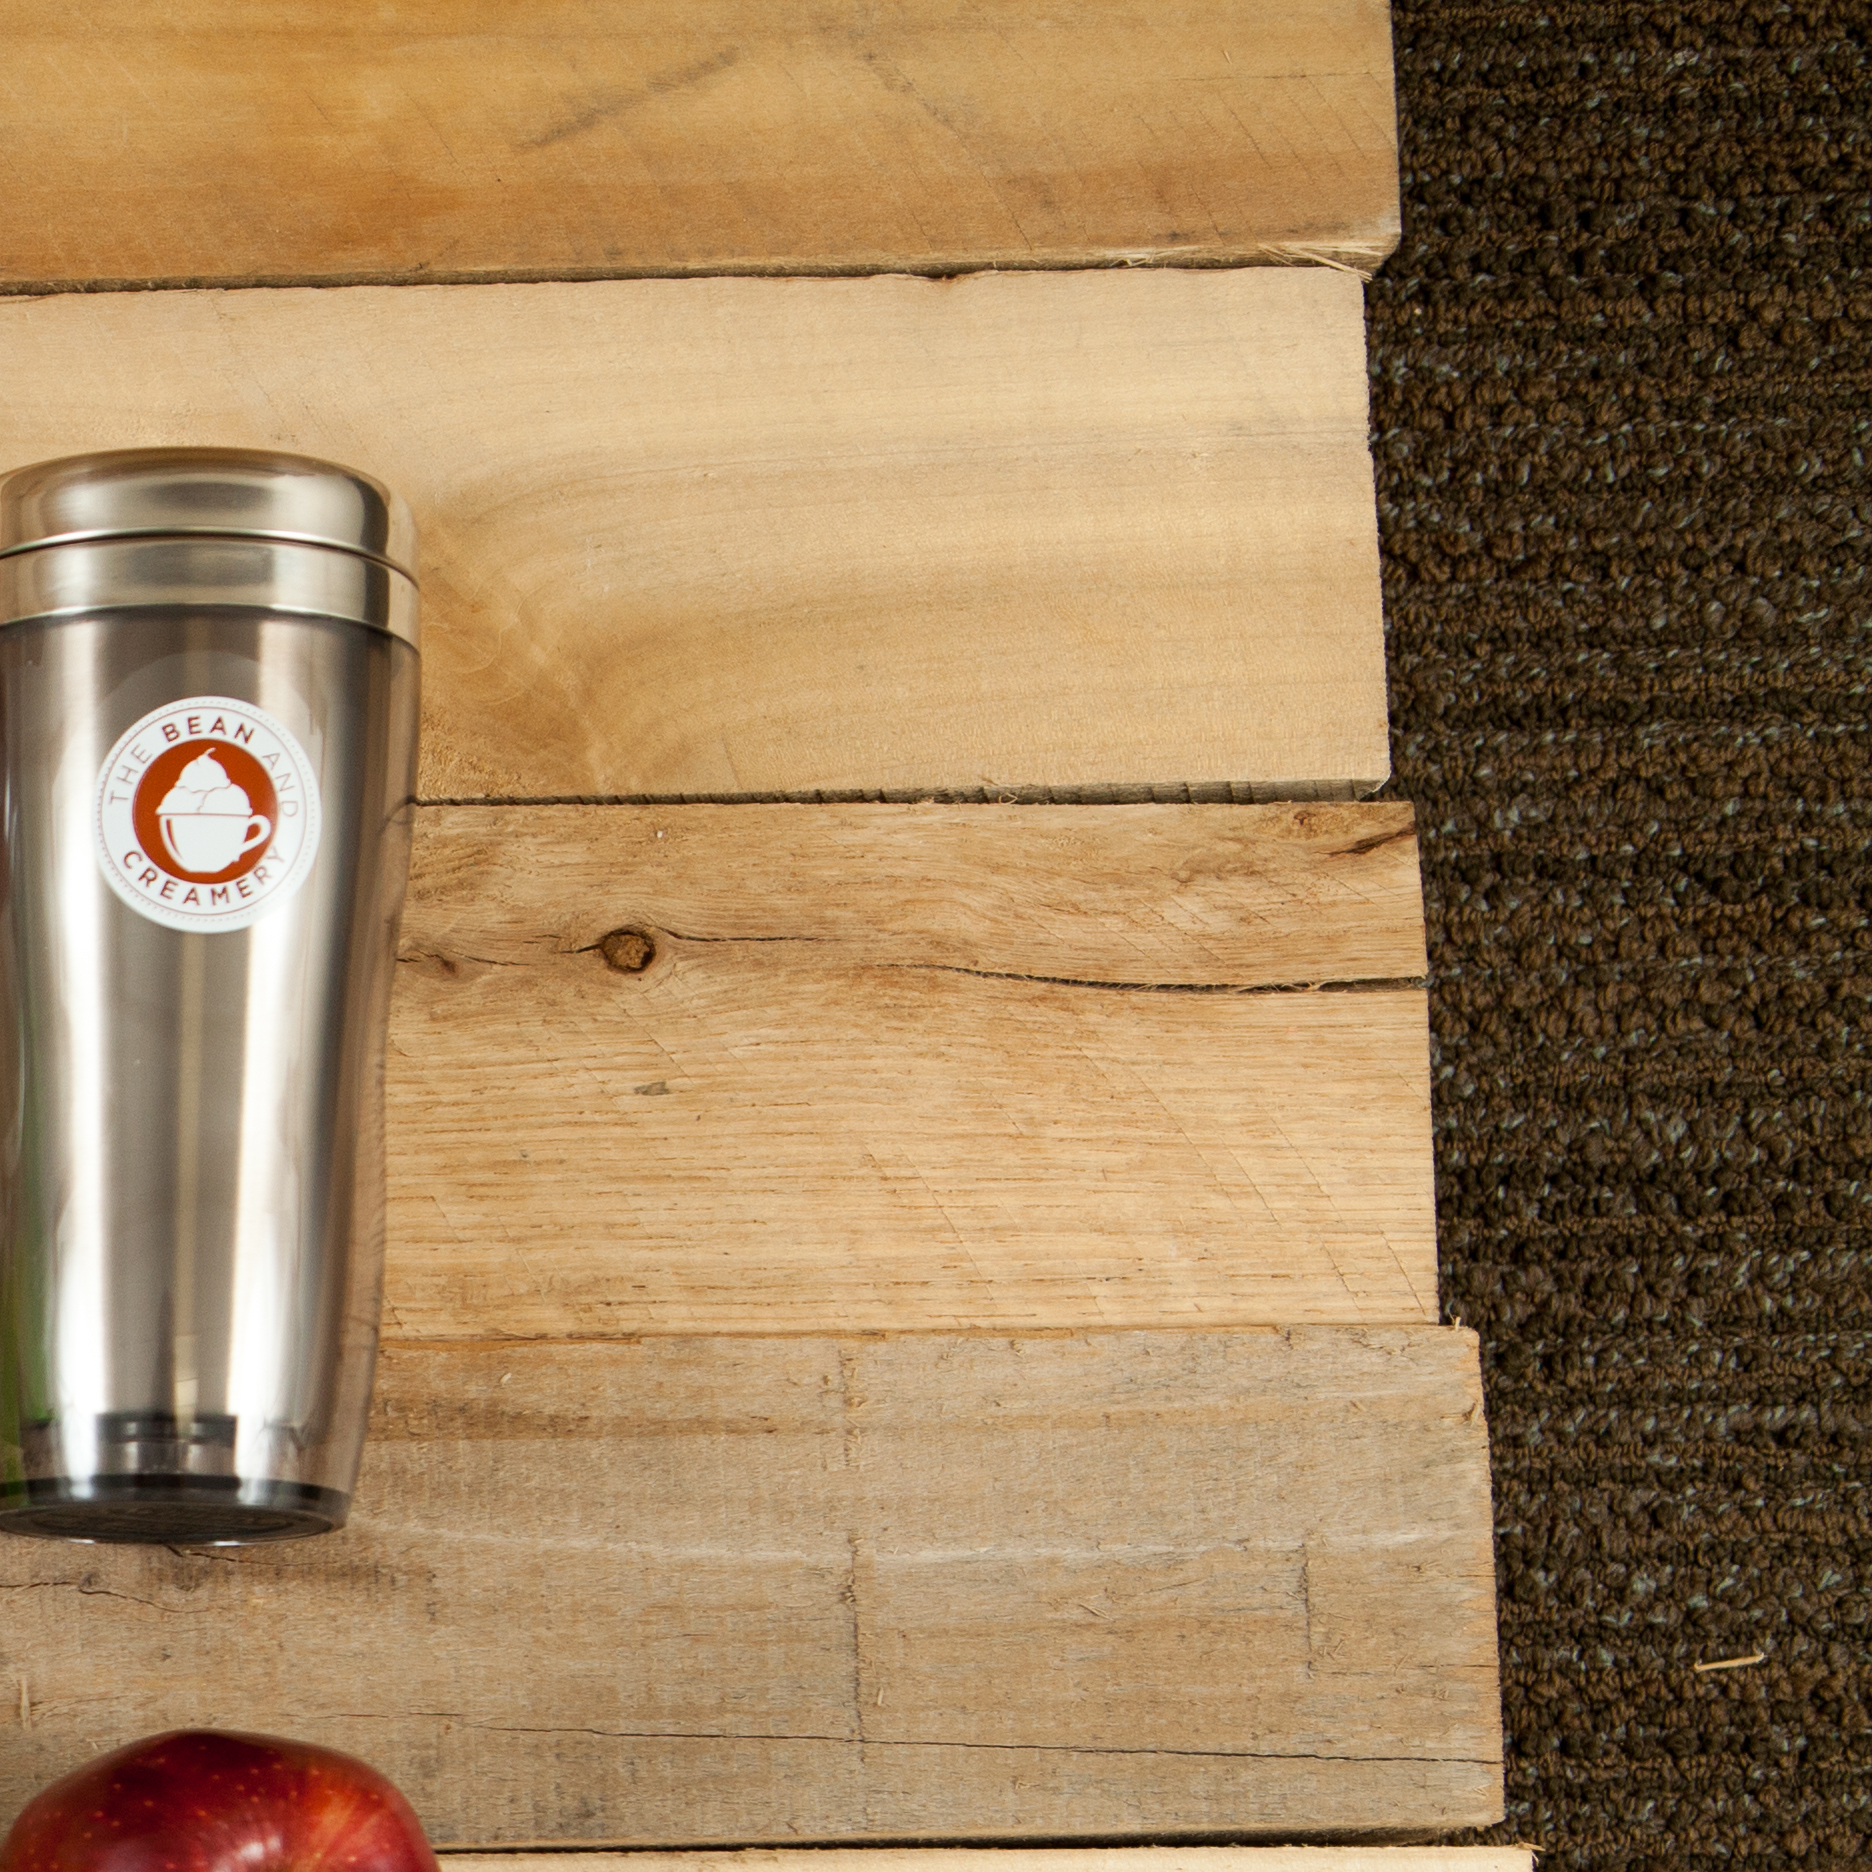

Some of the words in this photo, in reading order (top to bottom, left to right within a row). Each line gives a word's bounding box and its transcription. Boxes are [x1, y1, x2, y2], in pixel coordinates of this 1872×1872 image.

[109, 743, 154, 805] THE
[161, 715, 255, 744] BEAN
[262, 751, 299, 818] AND
[123, 845, 286, 907] CREAMERY
